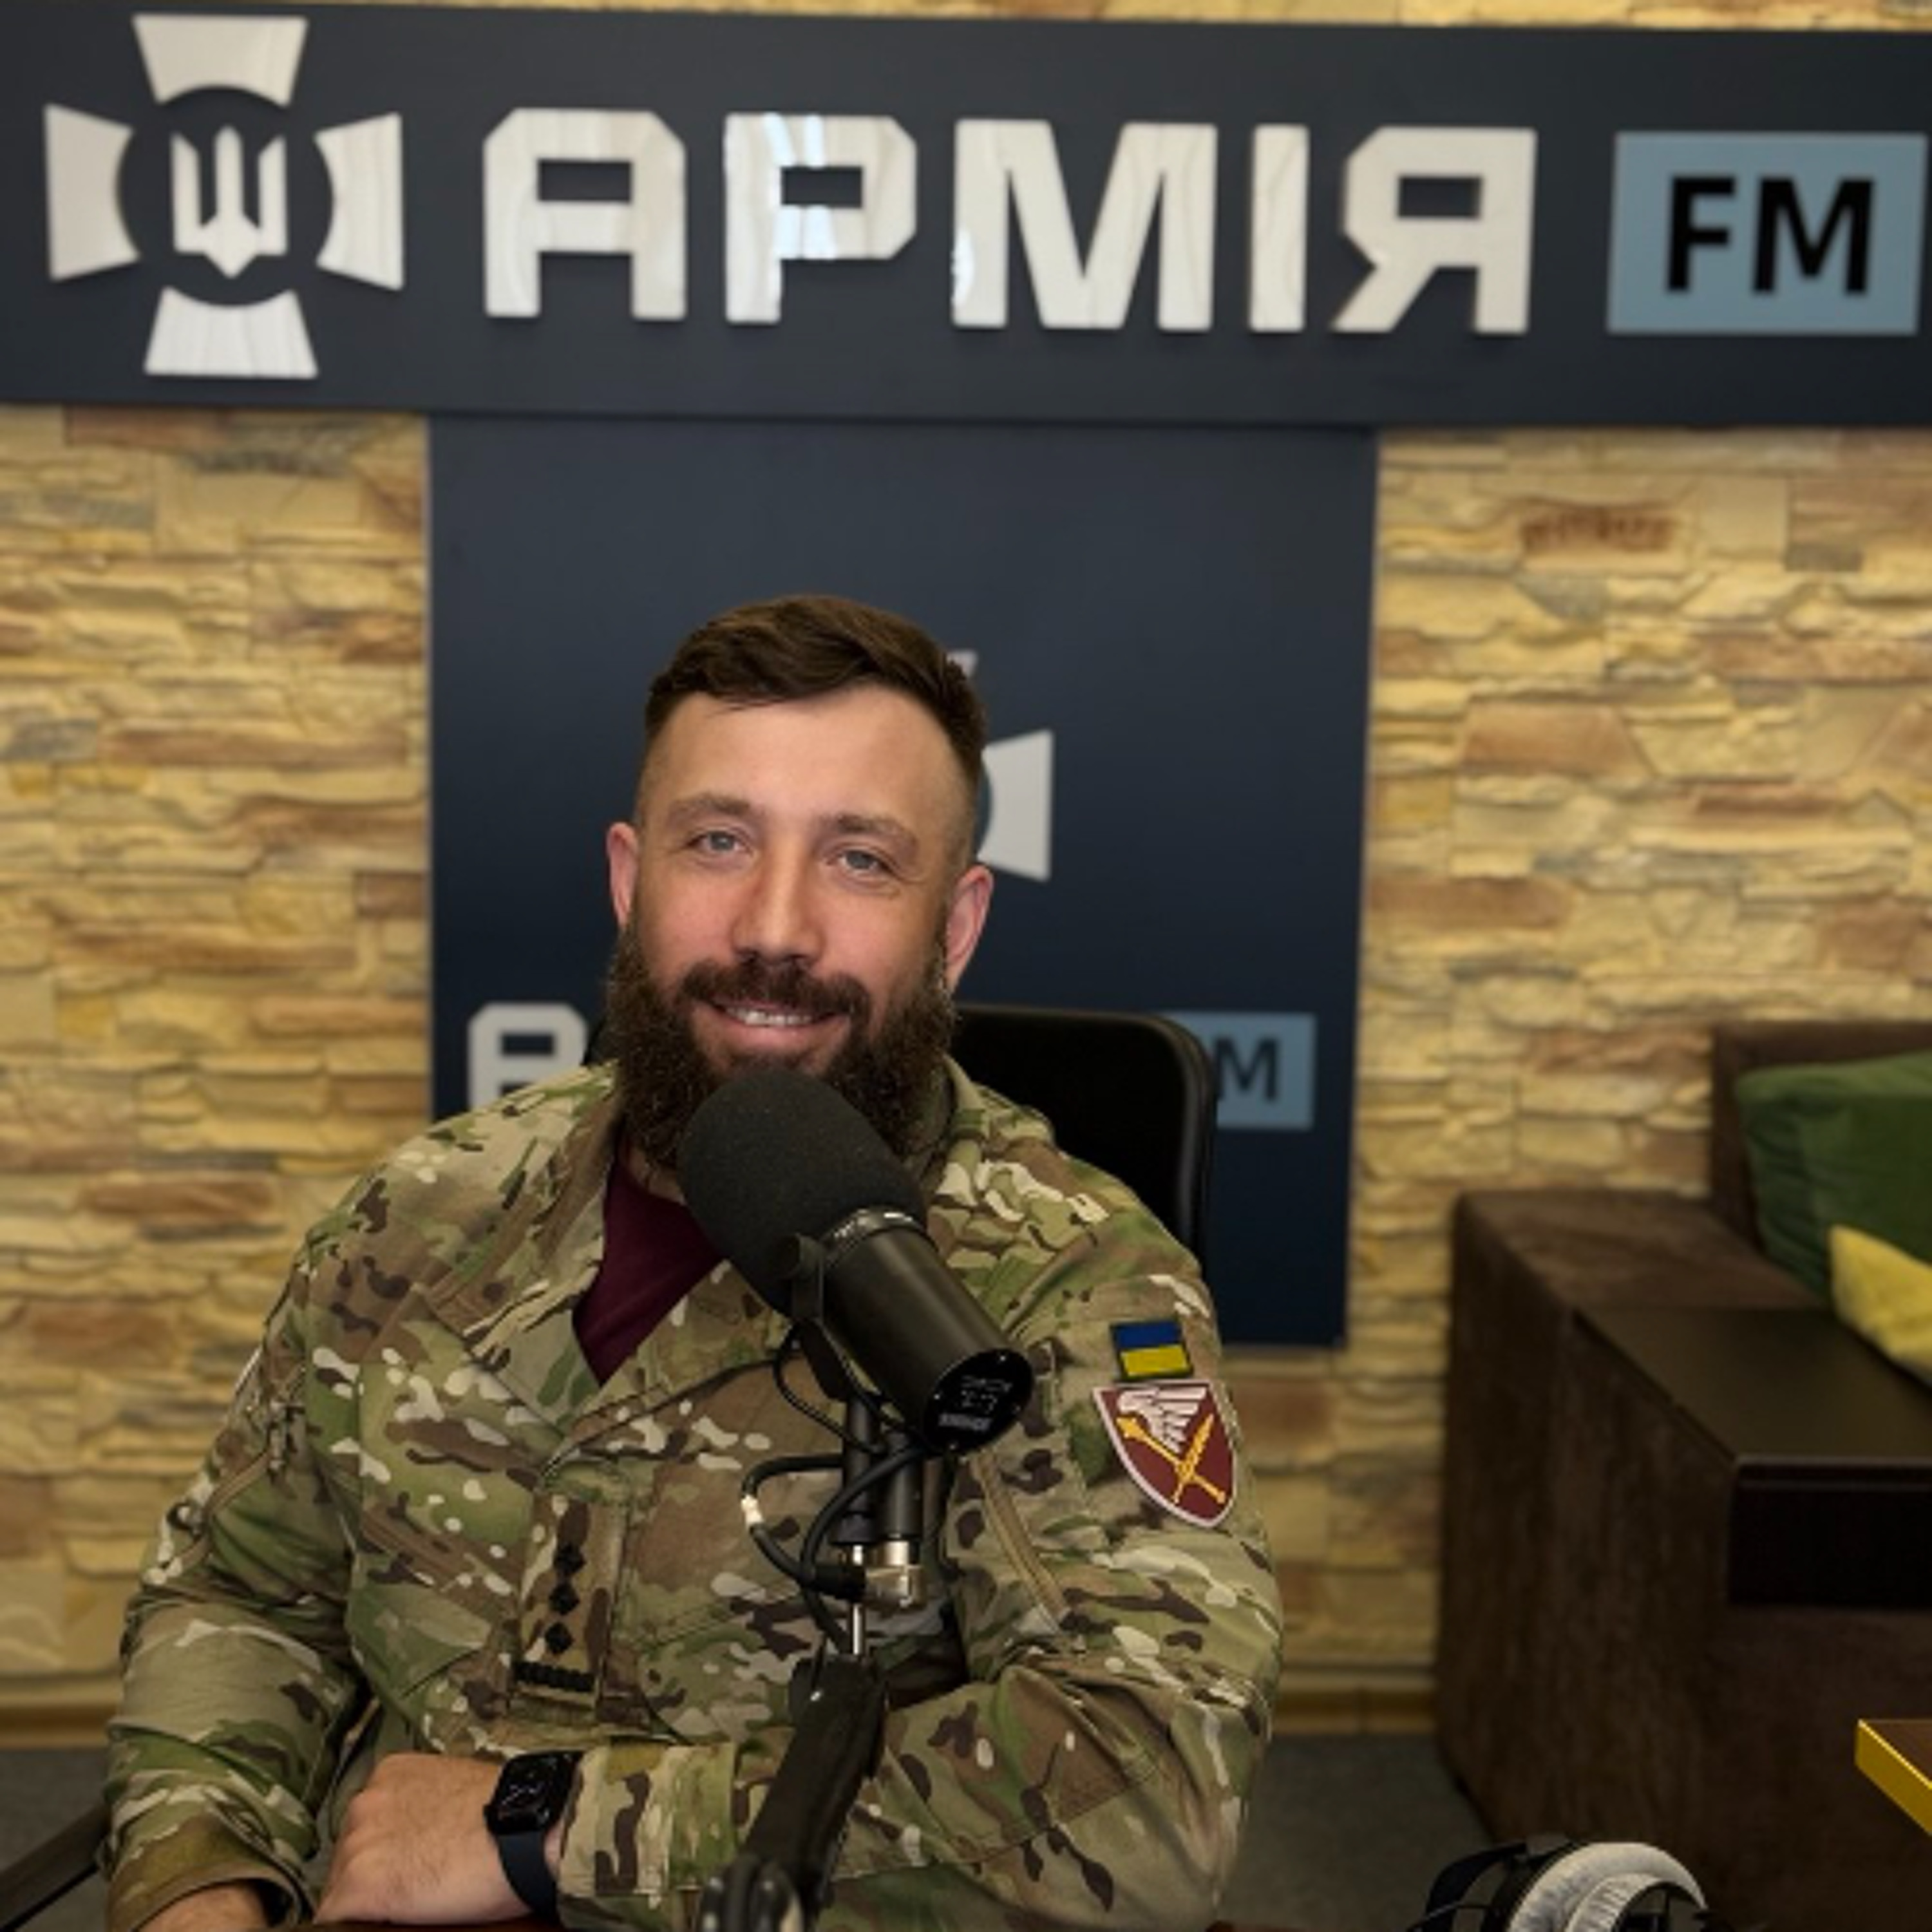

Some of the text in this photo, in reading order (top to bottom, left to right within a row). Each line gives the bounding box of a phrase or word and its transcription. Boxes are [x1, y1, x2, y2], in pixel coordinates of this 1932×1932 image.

[482, 108, 1875, 334] АРМІЯ FM
[1213, 1037, 1280, 1102] M
